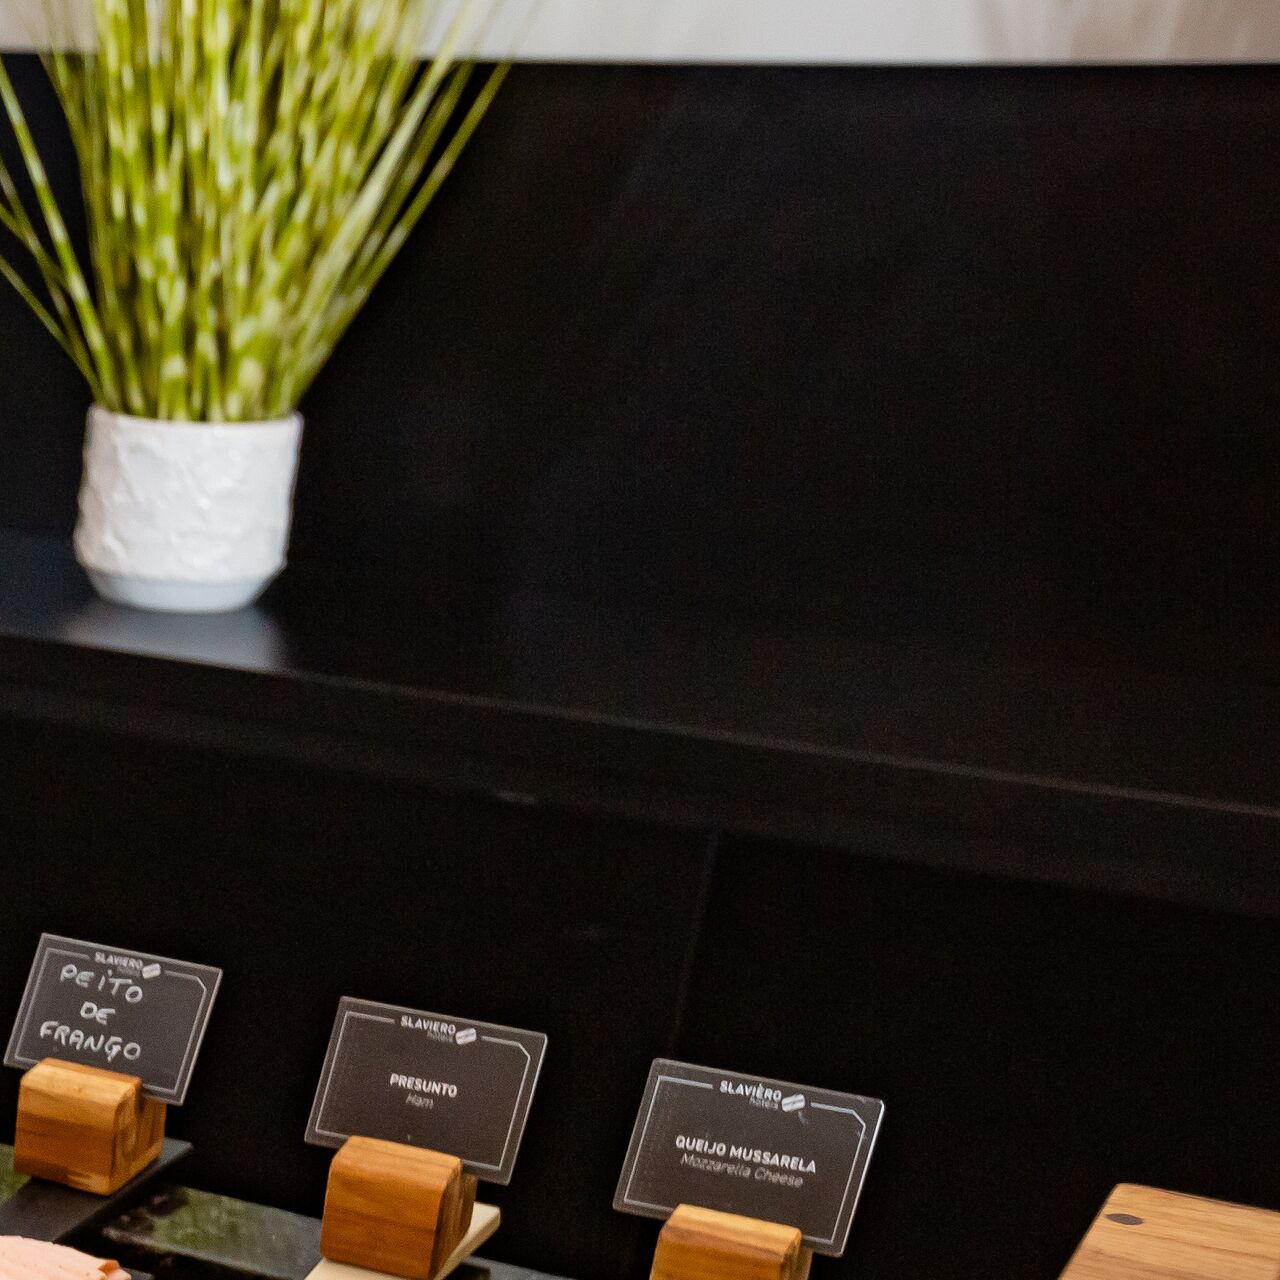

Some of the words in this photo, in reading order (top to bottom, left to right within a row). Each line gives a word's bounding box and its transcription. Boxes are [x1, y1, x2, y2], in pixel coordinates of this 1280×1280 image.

[60, 963, 143, 1004] PEITO
[80, 1001, 116, 1025] DE
[401, 1015, 457, 1036] SLAVIERO
[40, 1021, 141, 1062] FRANGO
[390, 1072, 458, 1098] PRESUNTO
[405, 1093, 435, 1110] Ham
[675, 1134, 727, 1157] QUEIJO
[729, 1144, 817, 1175] MUSSARELA
[680, 1152, 752, 1179] Mozzarella
[754, 1166, 804, 1188] Cheese
